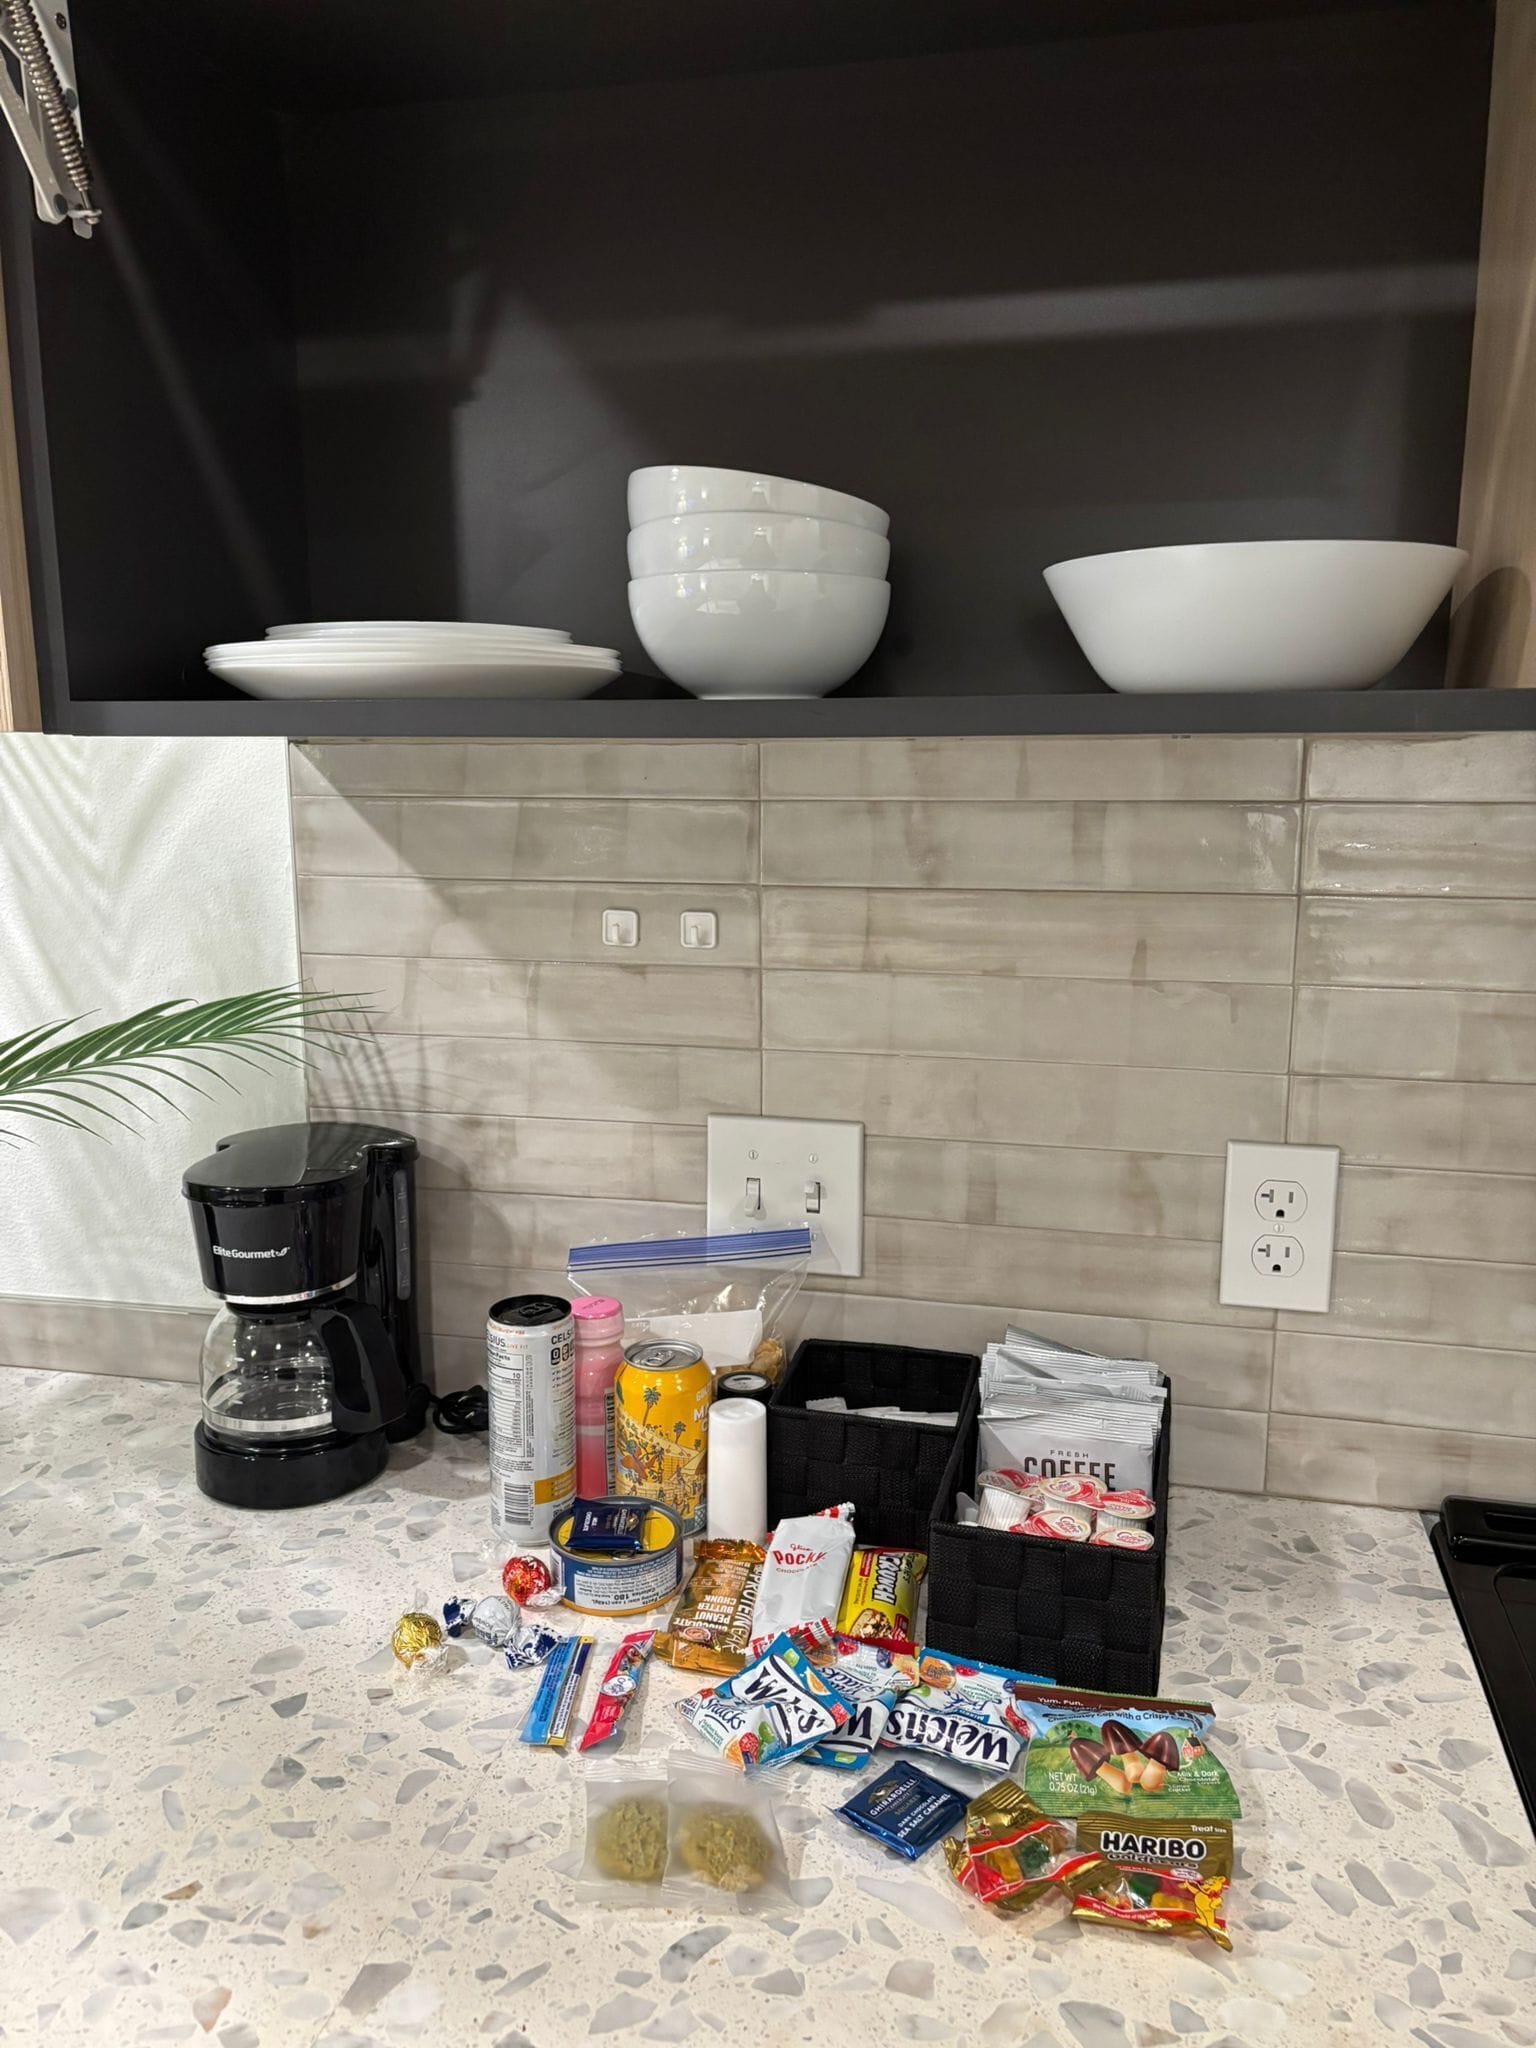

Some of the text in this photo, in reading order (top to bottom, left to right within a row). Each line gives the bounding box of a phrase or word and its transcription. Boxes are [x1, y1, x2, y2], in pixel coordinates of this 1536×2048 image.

[213, 1245, 277, 1260] EliteGourmet
[1050, 1449, 1089, 1459] FRESH
[772, 1550, 827, 1565] POCKY
[873, 1555, 901, 1605] CRUNCH
[614, 1593, 629, 1601] 180
[704, 1594, 737, 1606] CHUNK
[697, 1602, 734, 1614] BUTTER
[695, 1611, 731, 1625] PEANUT
[1038, 1697, 1061, 1705] Yum.
[700, 1698, 746, 1730] Snacks
[1115, 1712, 1134, 1720] with
[1142, 1712, 1169, 1721] Crispy
[886, 1710, 1009, 1764] Welch's
[1048, 1771, 1077, 1782] NET WT
[1201, 1769, 1220, 1777] Dark
[1049, 1781, 1098, 1797] 0.75 OZ (21g)
[869, 1778, 917, 1816] GHIRARDELLI
[897, 1793, 952, 1838] SEA SALT CARAMEL
[898, 1795, 936, 1828] DARK CHOCOLATE
[1101, 1830, 1206, 1861] HARIBO
